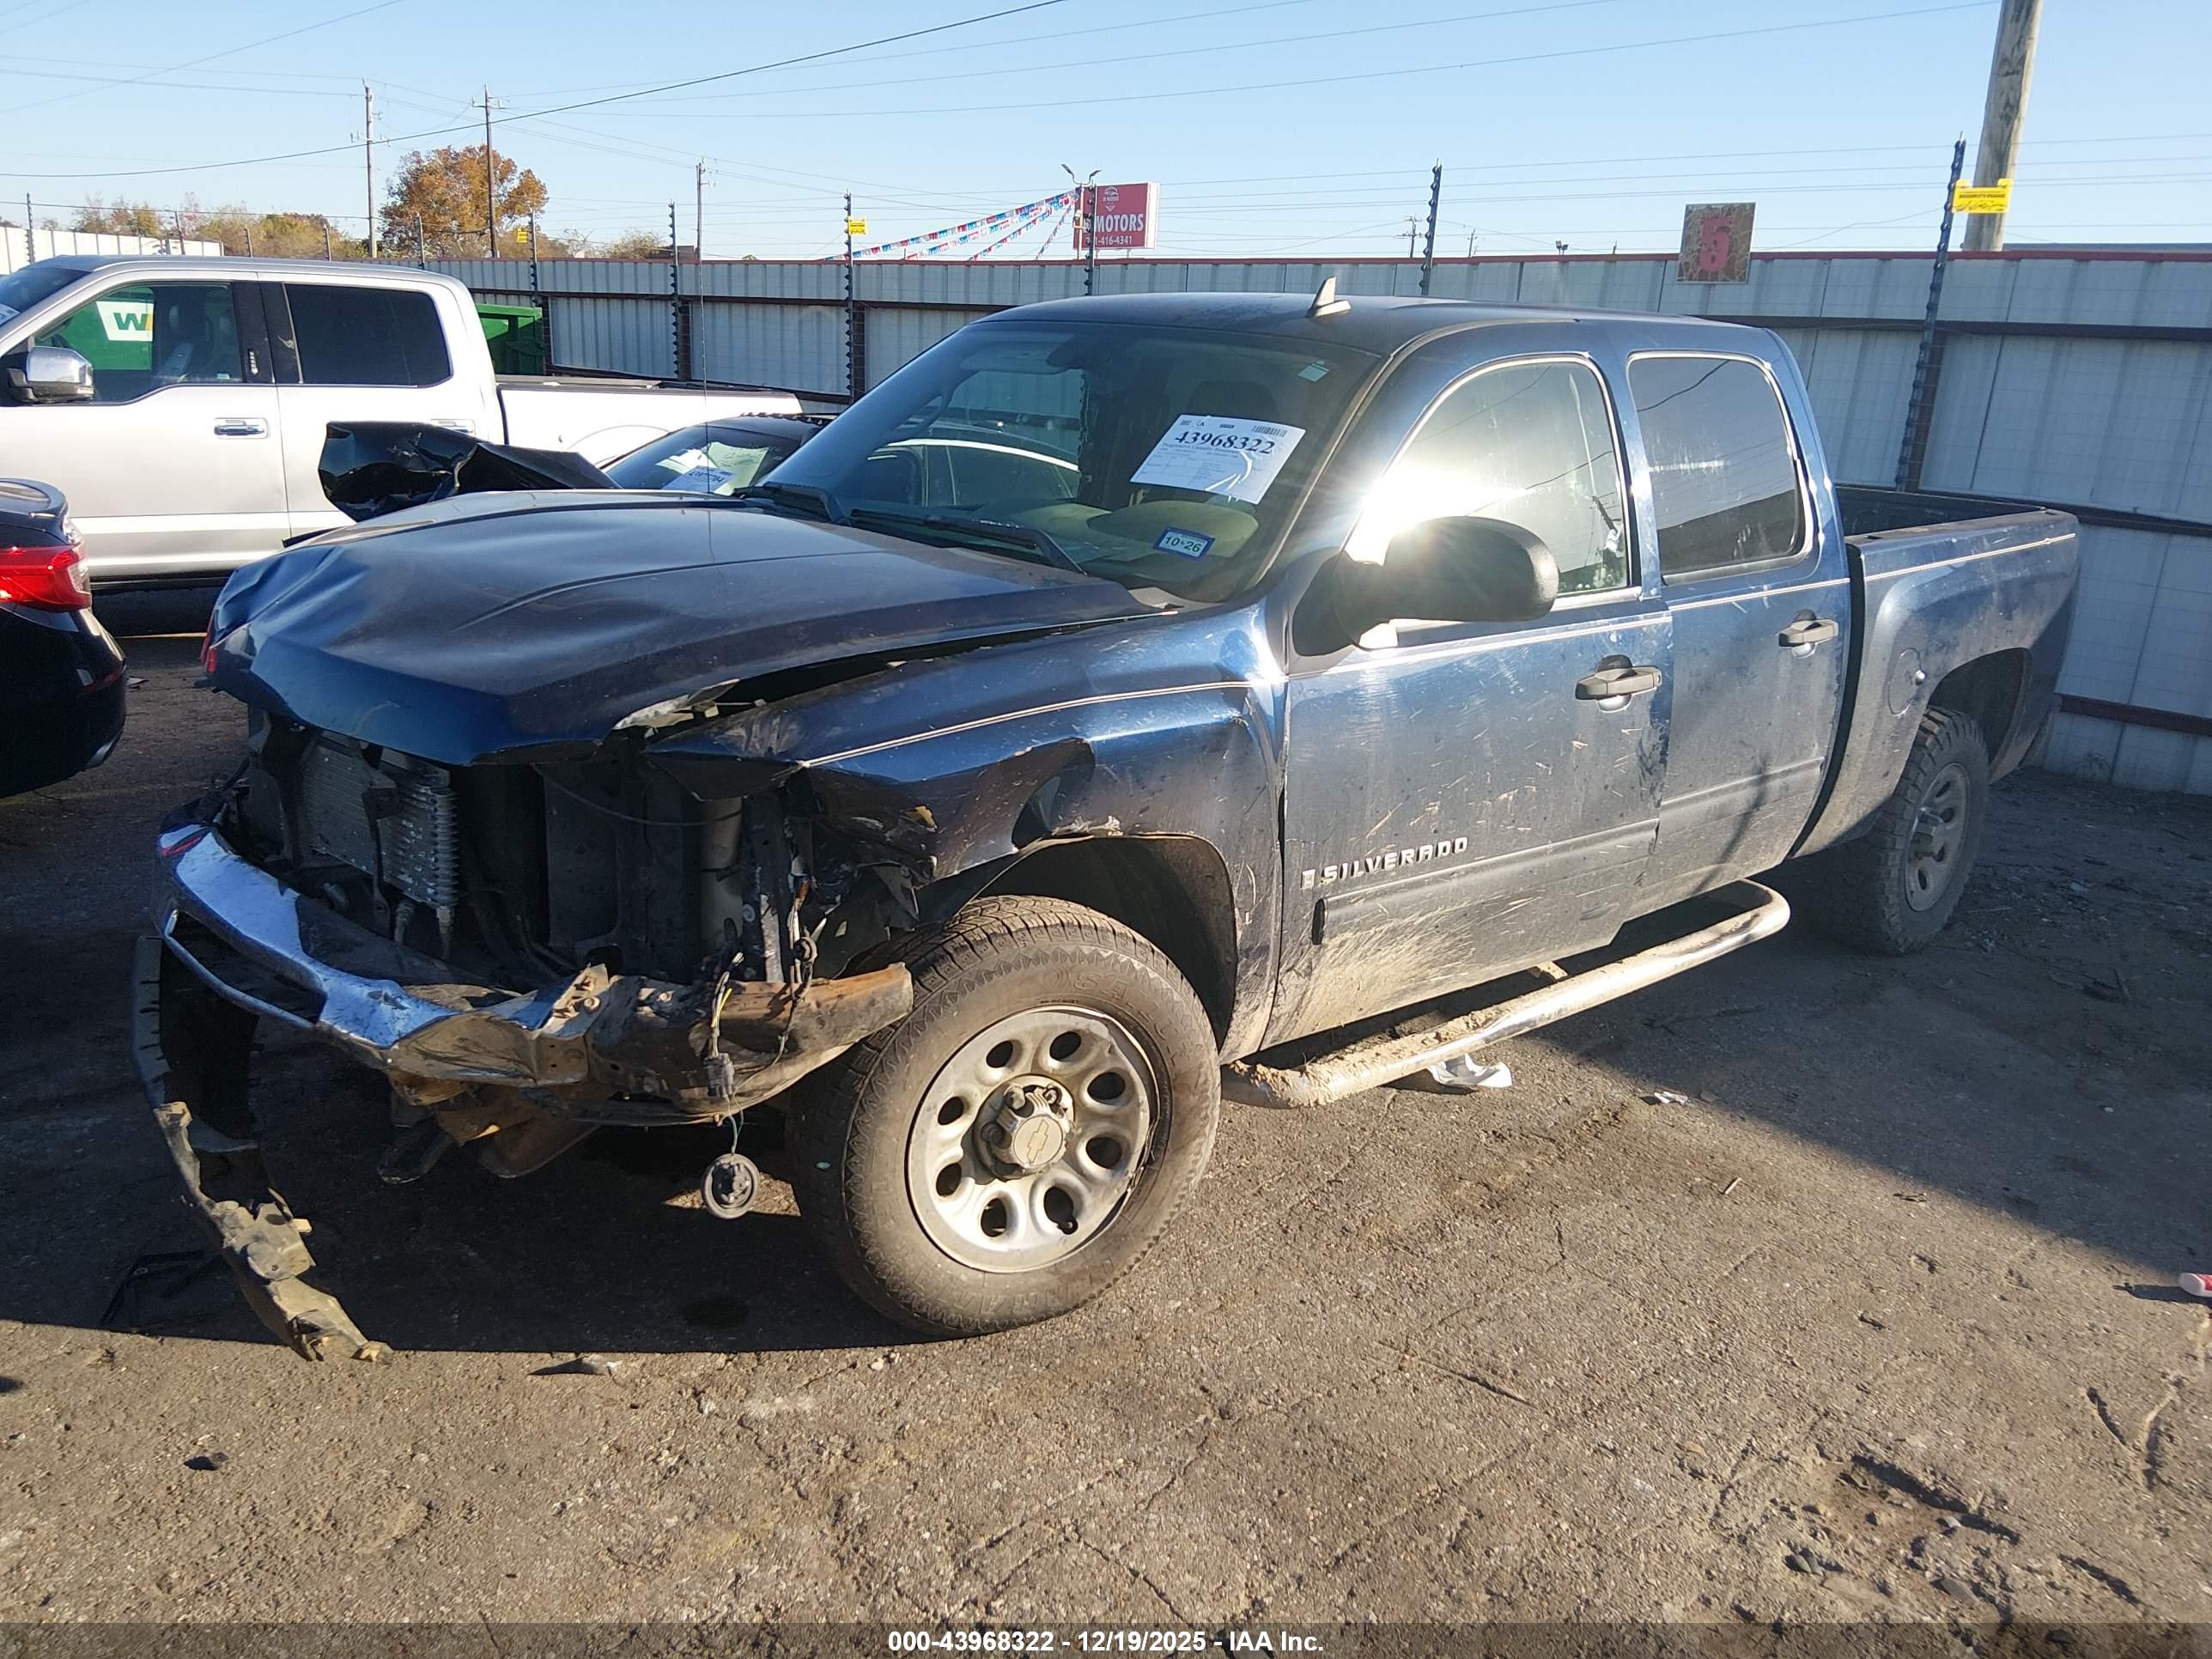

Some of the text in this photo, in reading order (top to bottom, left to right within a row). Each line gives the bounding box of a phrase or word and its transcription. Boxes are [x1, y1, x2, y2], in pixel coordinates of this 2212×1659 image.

[1096, 213, 1144, 233] MOTORS
[1174, 430, 1276, 454] 43968322
[1183, 541, 1202, 552] 26
[1322, 836, 1468, 883] SILVERADO
